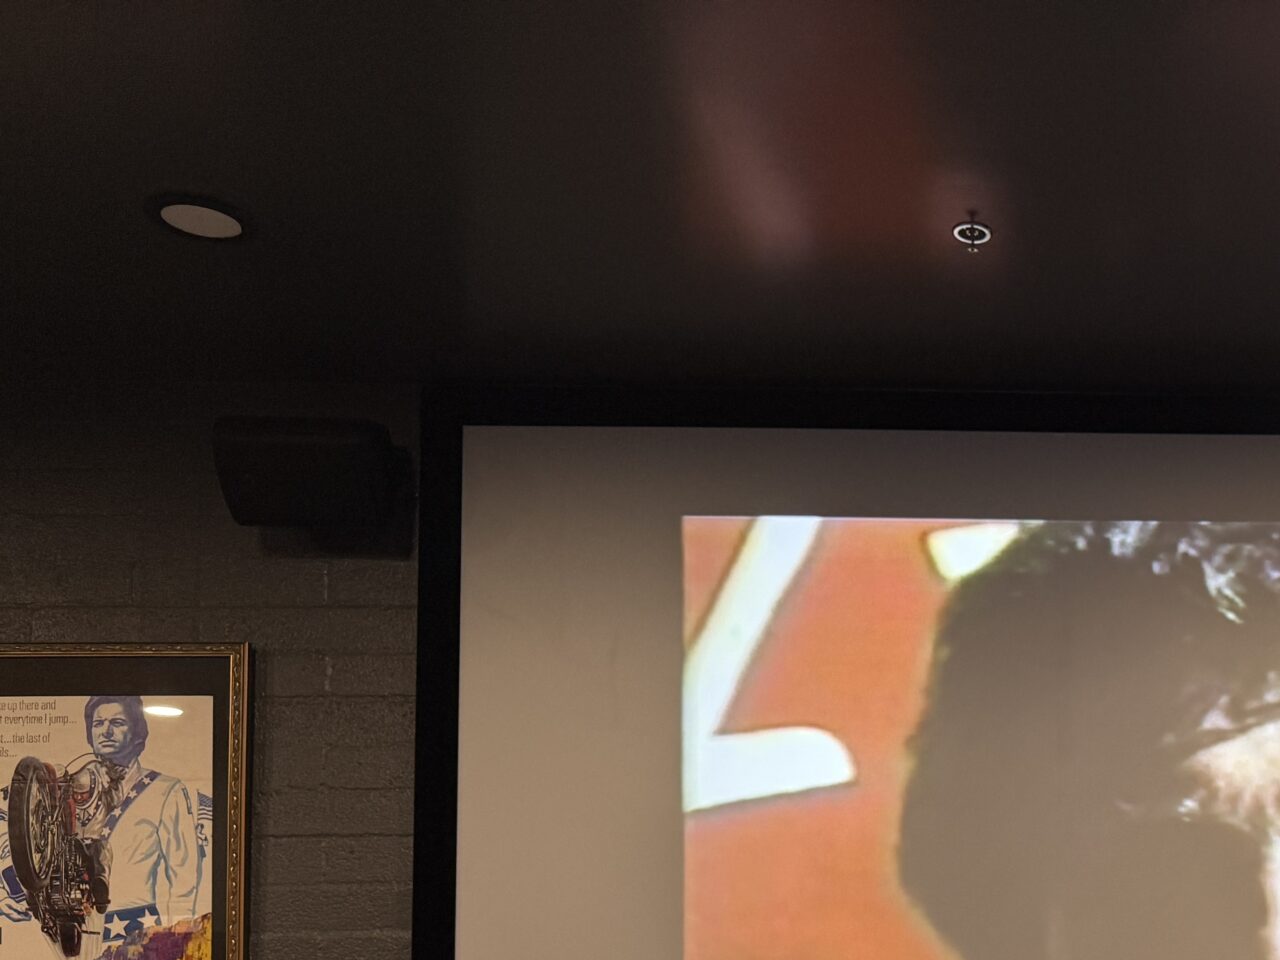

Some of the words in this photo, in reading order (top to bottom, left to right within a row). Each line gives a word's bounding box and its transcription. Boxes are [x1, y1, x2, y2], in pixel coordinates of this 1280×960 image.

[7, 702, 18, 713] up
[19, 699, 39, 711] there
[41, 699, 56, 711] and
[5, 713, 43, 726] everytime
[27, 732, 41, 744] last
[42, 732, 51, 743] of
